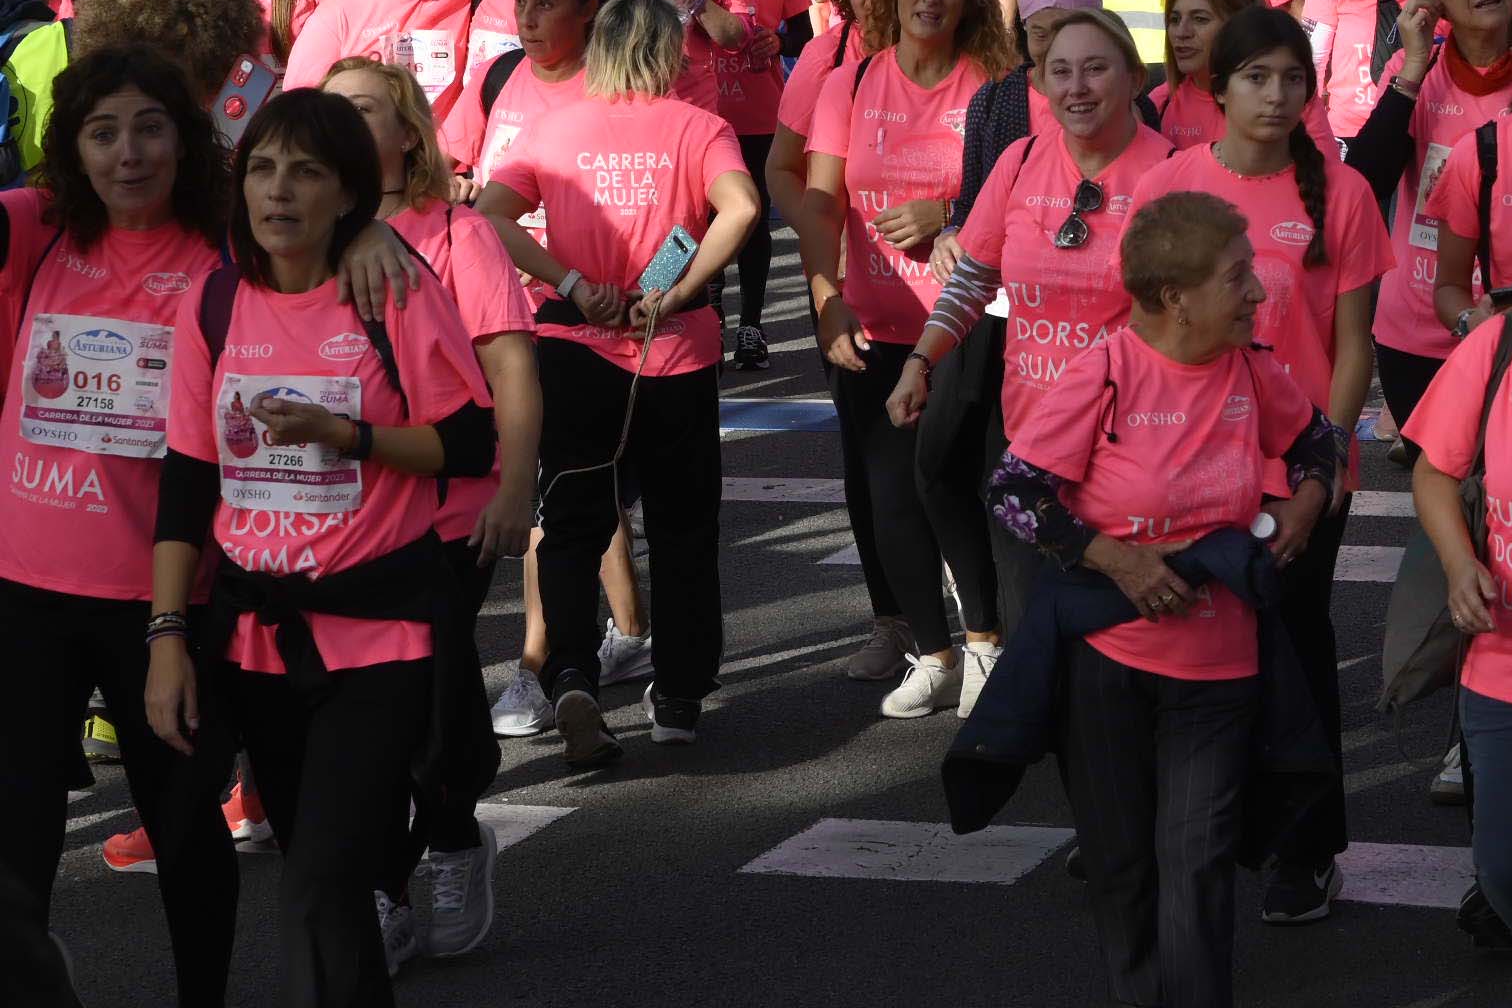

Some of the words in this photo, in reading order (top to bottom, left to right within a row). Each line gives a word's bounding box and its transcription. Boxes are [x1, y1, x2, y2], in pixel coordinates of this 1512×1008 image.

[864, 108, 907, 123] OYSHO
[576, 152, 673, 170] CARRERA
[596, 171, 625, 187] DE
[630, 171, 656, 187] LA
[593, 188, 660, 206] MUJER
[858, 190, 888, 213] TU
[1026, 196, 1071, 209] OYSHO
[1009, 281, 1041, 307] TU
[1016, 317, 1115, 349] DORSA
[73, 339, 128, 355] ASTURIANA
[73, 370, 121, 392] 016
[76, 395, 114, 410] 27158
[38, 410, 78, 421] CARRERA
[104, 416, 133, 426] MUJER
[1127, 411, 1187, 427] OYSHO
[31, 426, 78, 442] OYSHO
[112, 435, 160, 448] Santander
[268, 453, 304, 467] 27266
[12, 451, 105, 501] SUMA
[232, 488, 271, 501] OYSHO
[304, 492, 350, 503] Santander
